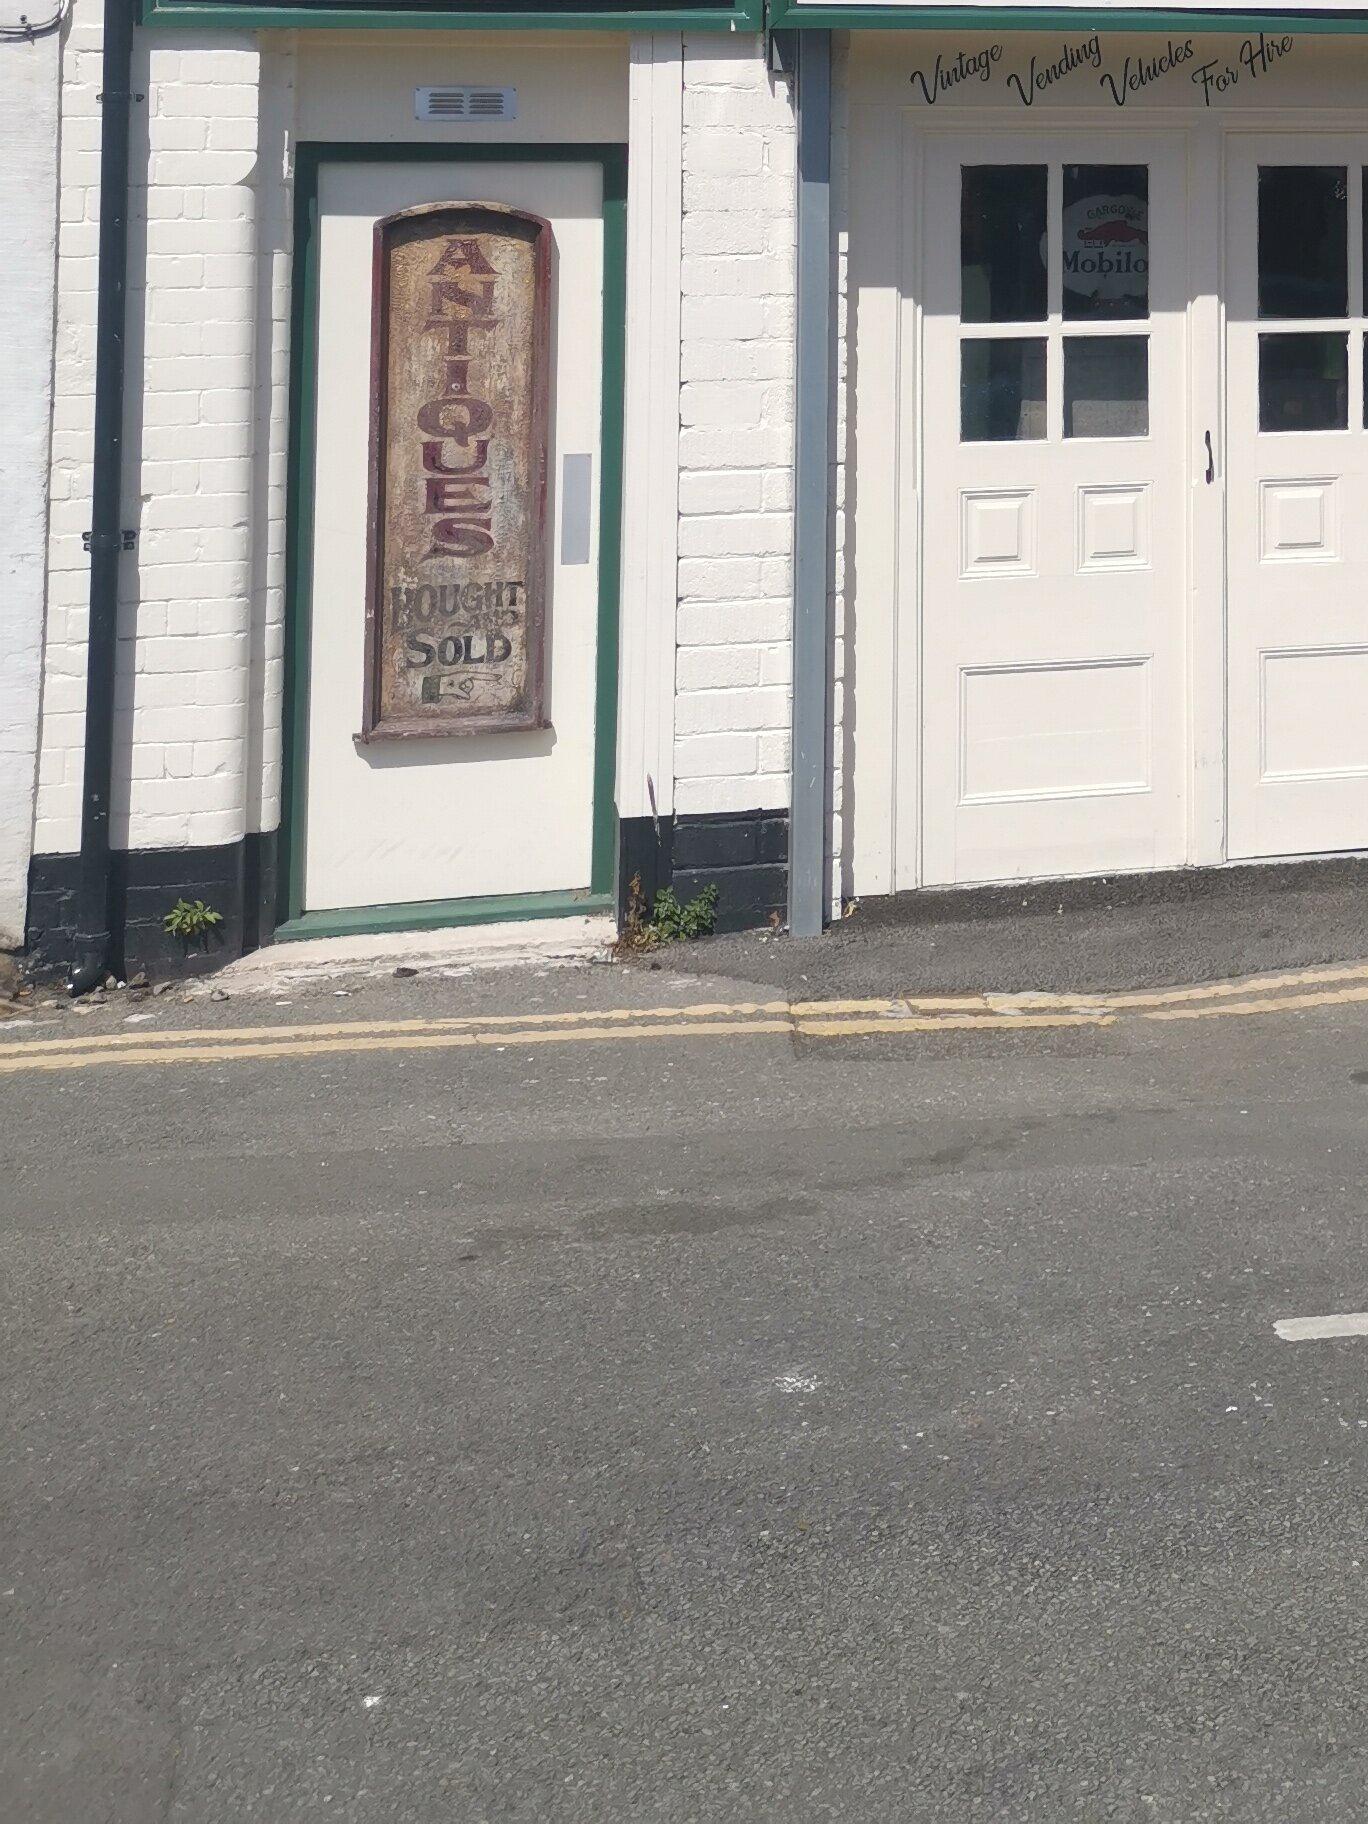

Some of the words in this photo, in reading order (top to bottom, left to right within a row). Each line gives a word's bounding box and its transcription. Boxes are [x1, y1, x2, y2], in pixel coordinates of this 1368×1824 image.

[910, 43, 1003, 105] Vintage
[1007, 32, 1101, 106] Vending
[1100, 38, 1195, 107] Vehicles
[1192, 58, 1239, 107] For
[1239, 32, 1294, 78] Hire
[1062, 250, 1148, 274] Mobilo
[416, 238, 502, 560] ANTIQUES
[405, 629, 512, 669] SOLD
